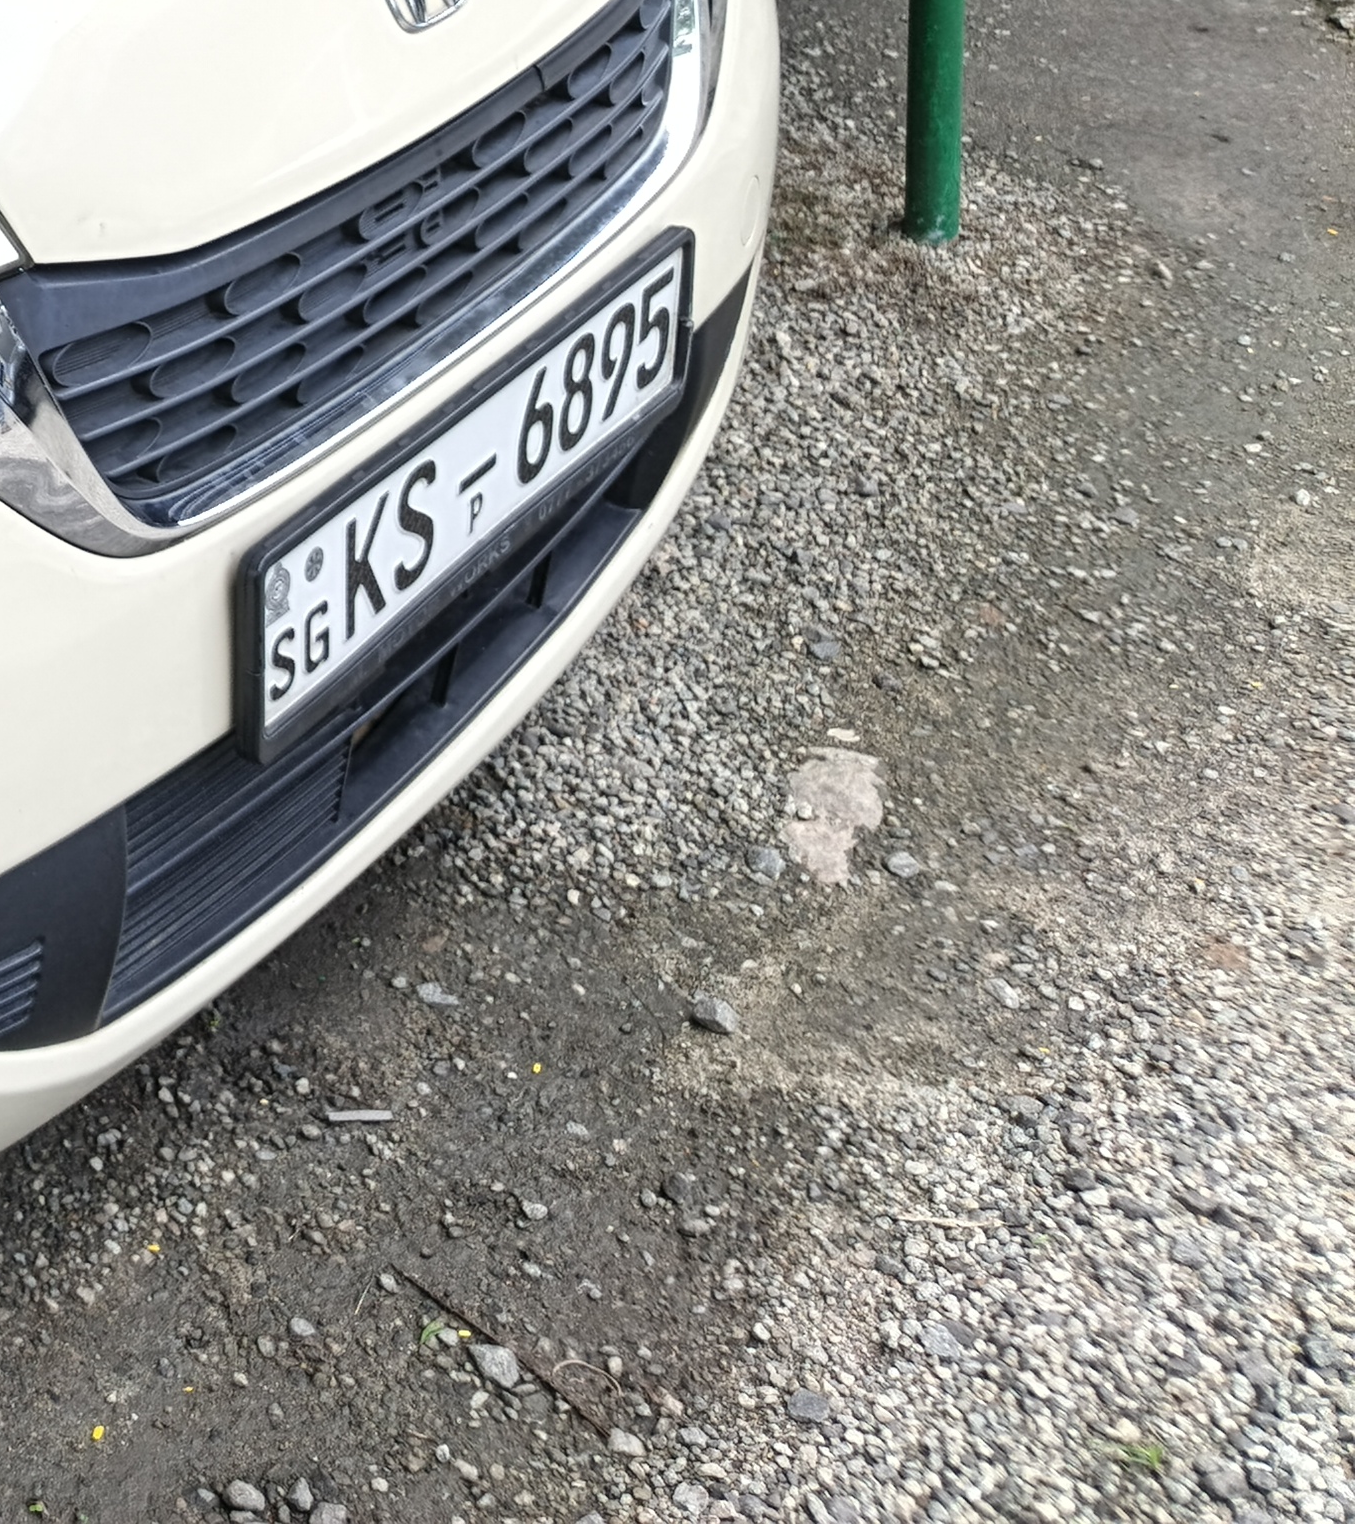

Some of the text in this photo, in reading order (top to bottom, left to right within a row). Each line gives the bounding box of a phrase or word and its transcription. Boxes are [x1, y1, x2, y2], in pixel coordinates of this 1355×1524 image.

[344, 457, 438, 641] KS
[516, 266, 677, 485] 6895
[269, 599, 331, 702] SG
